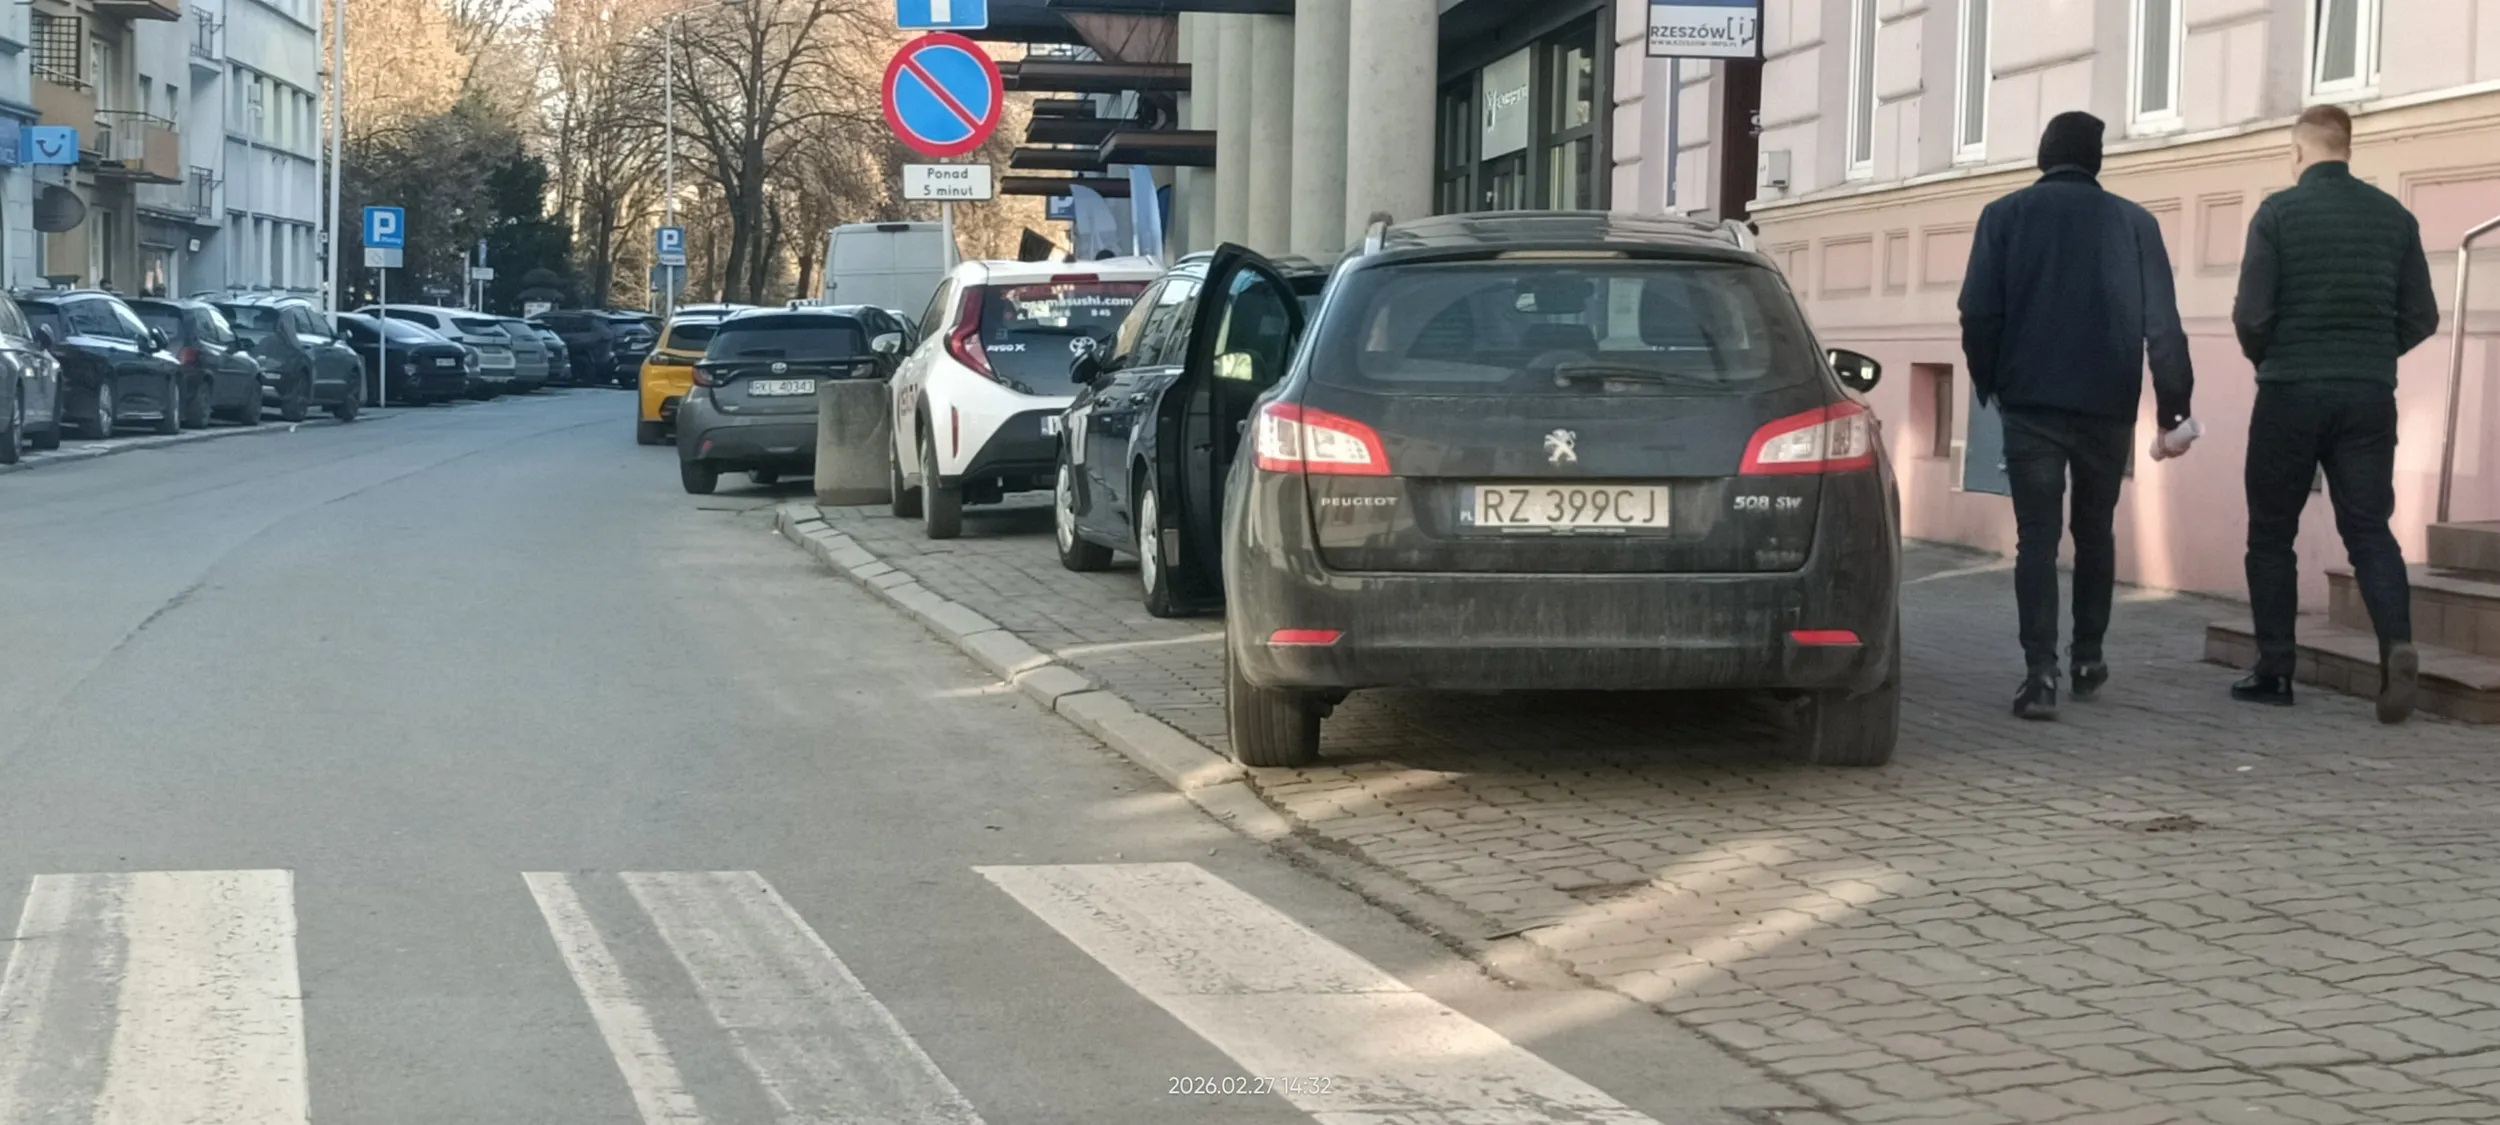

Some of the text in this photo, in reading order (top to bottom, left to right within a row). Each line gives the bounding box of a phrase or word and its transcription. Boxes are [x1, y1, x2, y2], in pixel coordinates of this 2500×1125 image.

[1650, 23, 1725, 38] RZESZÓW
[927, 167, 969, 179] Ponad
[923, 184, 973, 196] 5 minut
[373, 211, 396, 242] P
[662, 230, 678, 250] P
[1321, 496, 1398, 506] PEUGEOT
[1484, 489, 1530, 523] RZ
[1546, 489, 1656, 523] 399CJ
[1733, 495, 1803, 510] 508 SW
